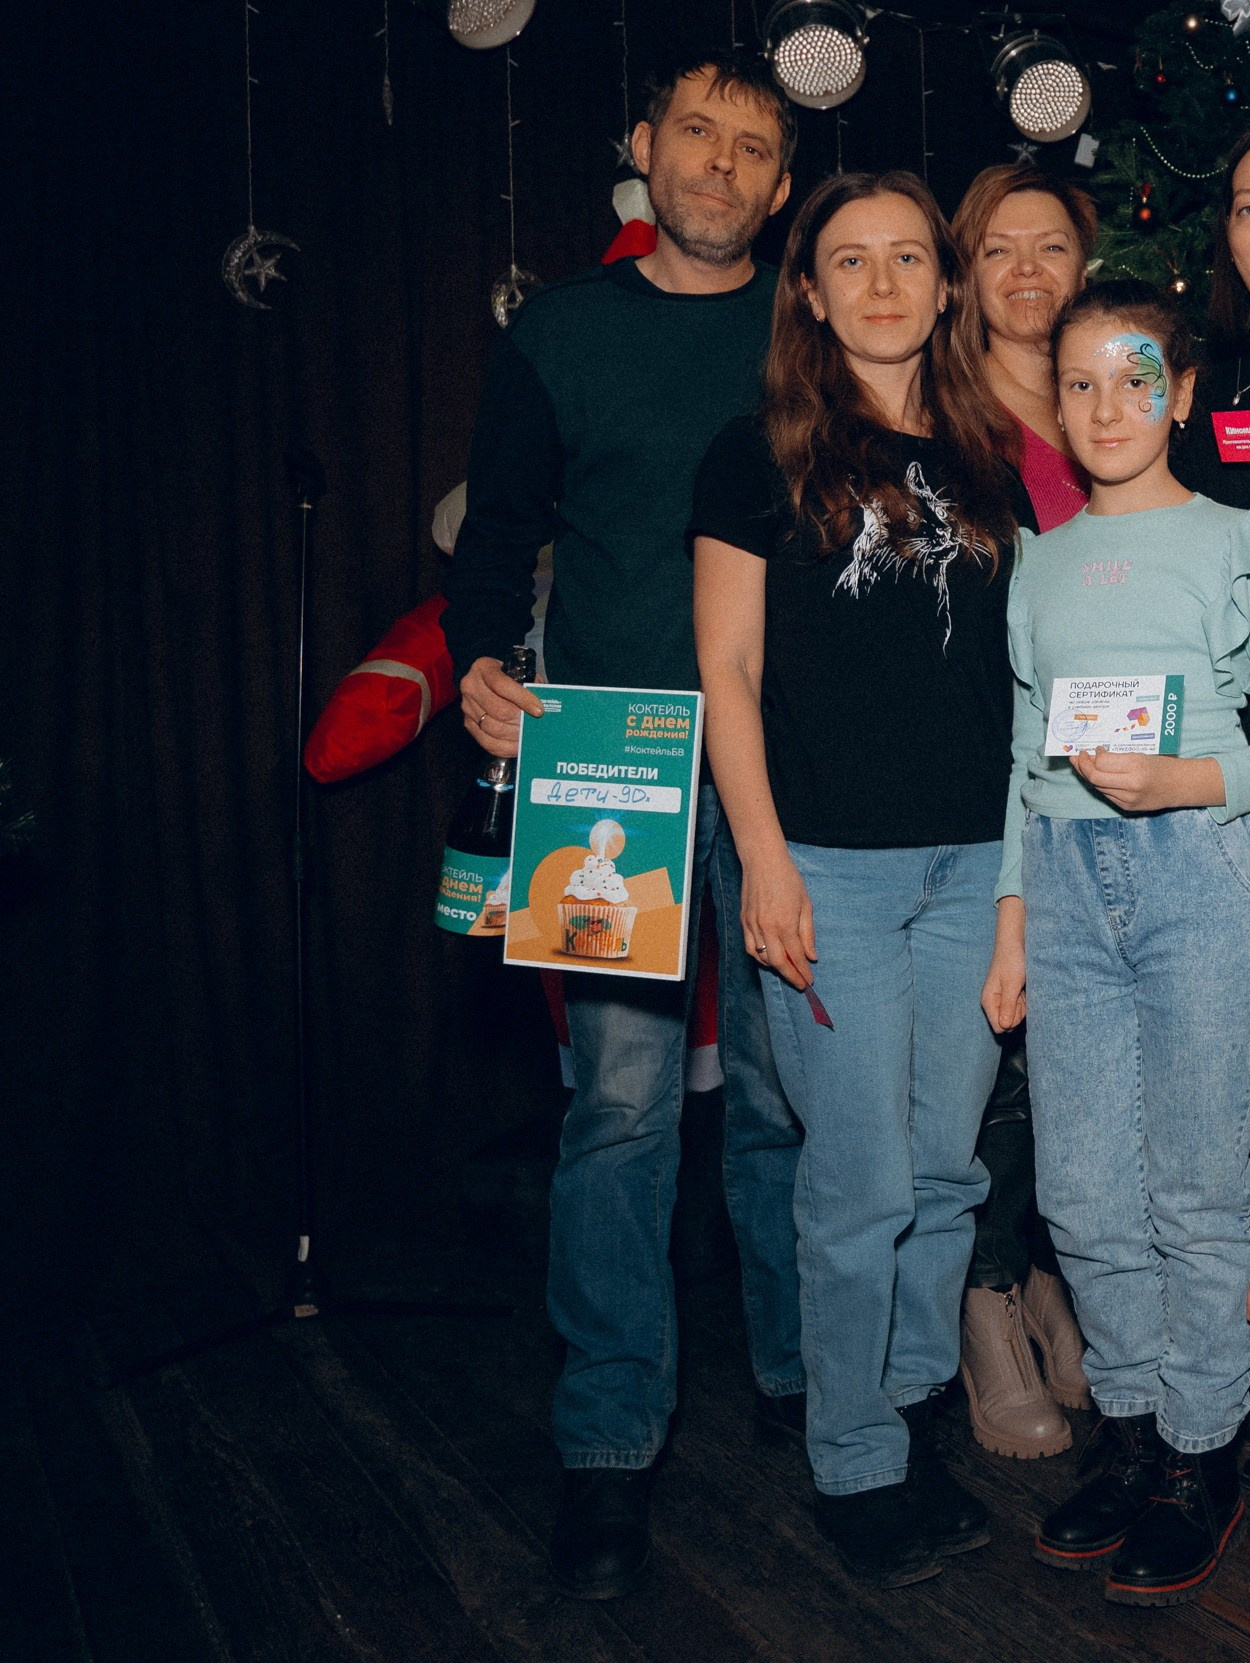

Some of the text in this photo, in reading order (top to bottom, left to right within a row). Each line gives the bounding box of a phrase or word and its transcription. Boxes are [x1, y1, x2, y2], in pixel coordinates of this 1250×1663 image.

[1082, 560, 1132, 573] SMILE
[1070, 678, 1140, 689] ПОДАРОЧНЫЙ
[1069, 690, 1134, 698] СЕРТИФИКАТ
[628, 703, 690, 716] КОКТЕЙЛЬ
[626, 715, 690, 729] с днем
[1165, 704, 1177, 736] 2000
[626, 728, 688, 739] рождения!
[556, 762, 658, 780] ПОБЕДИТЕЛИ
[440, 864, 484, 882] КТЕЙЛЬ
